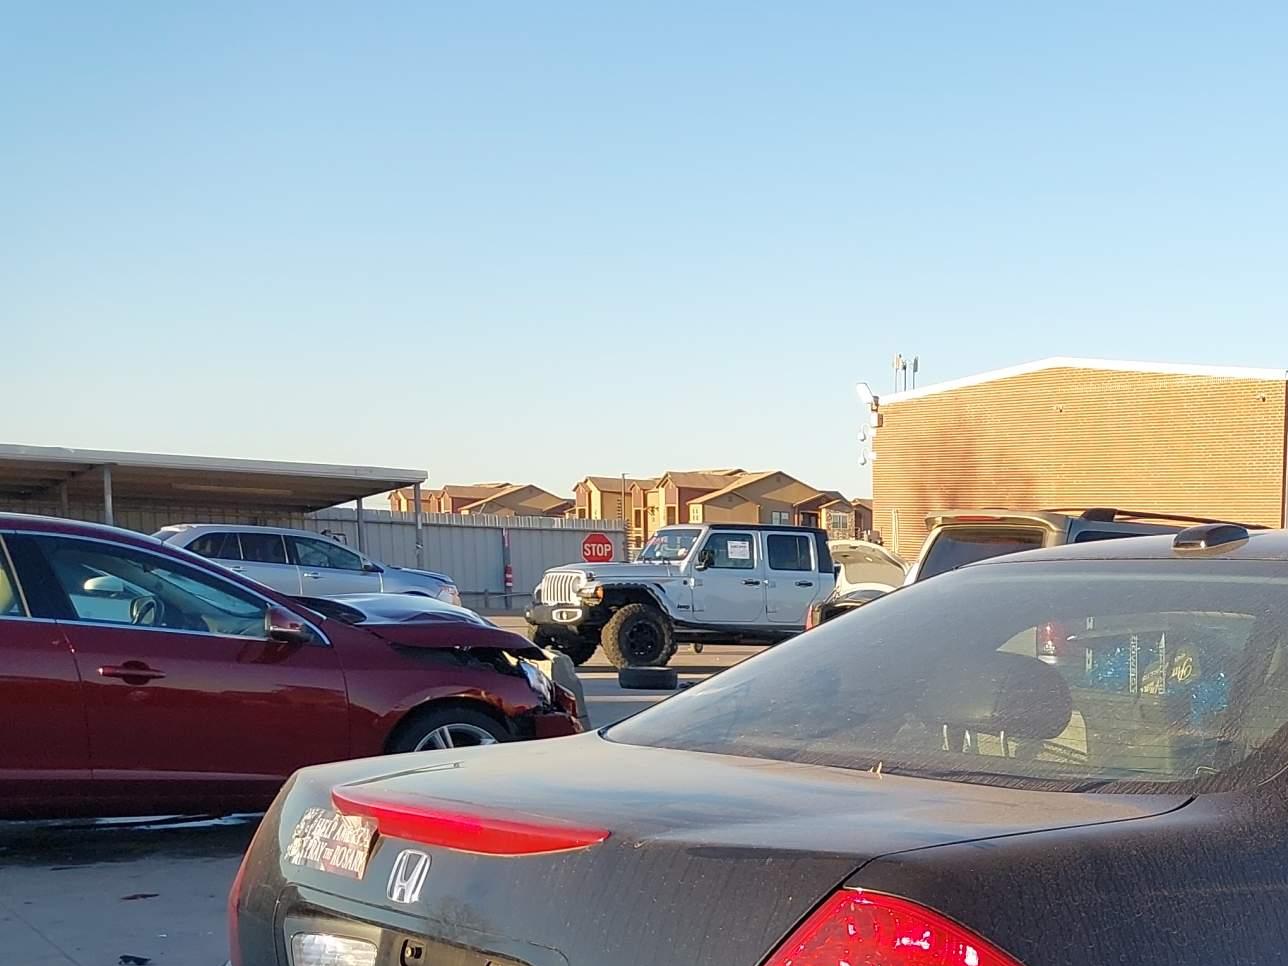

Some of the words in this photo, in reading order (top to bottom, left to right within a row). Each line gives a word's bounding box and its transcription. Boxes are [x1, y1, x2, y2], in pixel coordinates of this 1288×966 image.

[583, 543, 612, 557] STOP
[313, 816, 339, 841] HELP
[303, 836, 328, 862] PRAY
